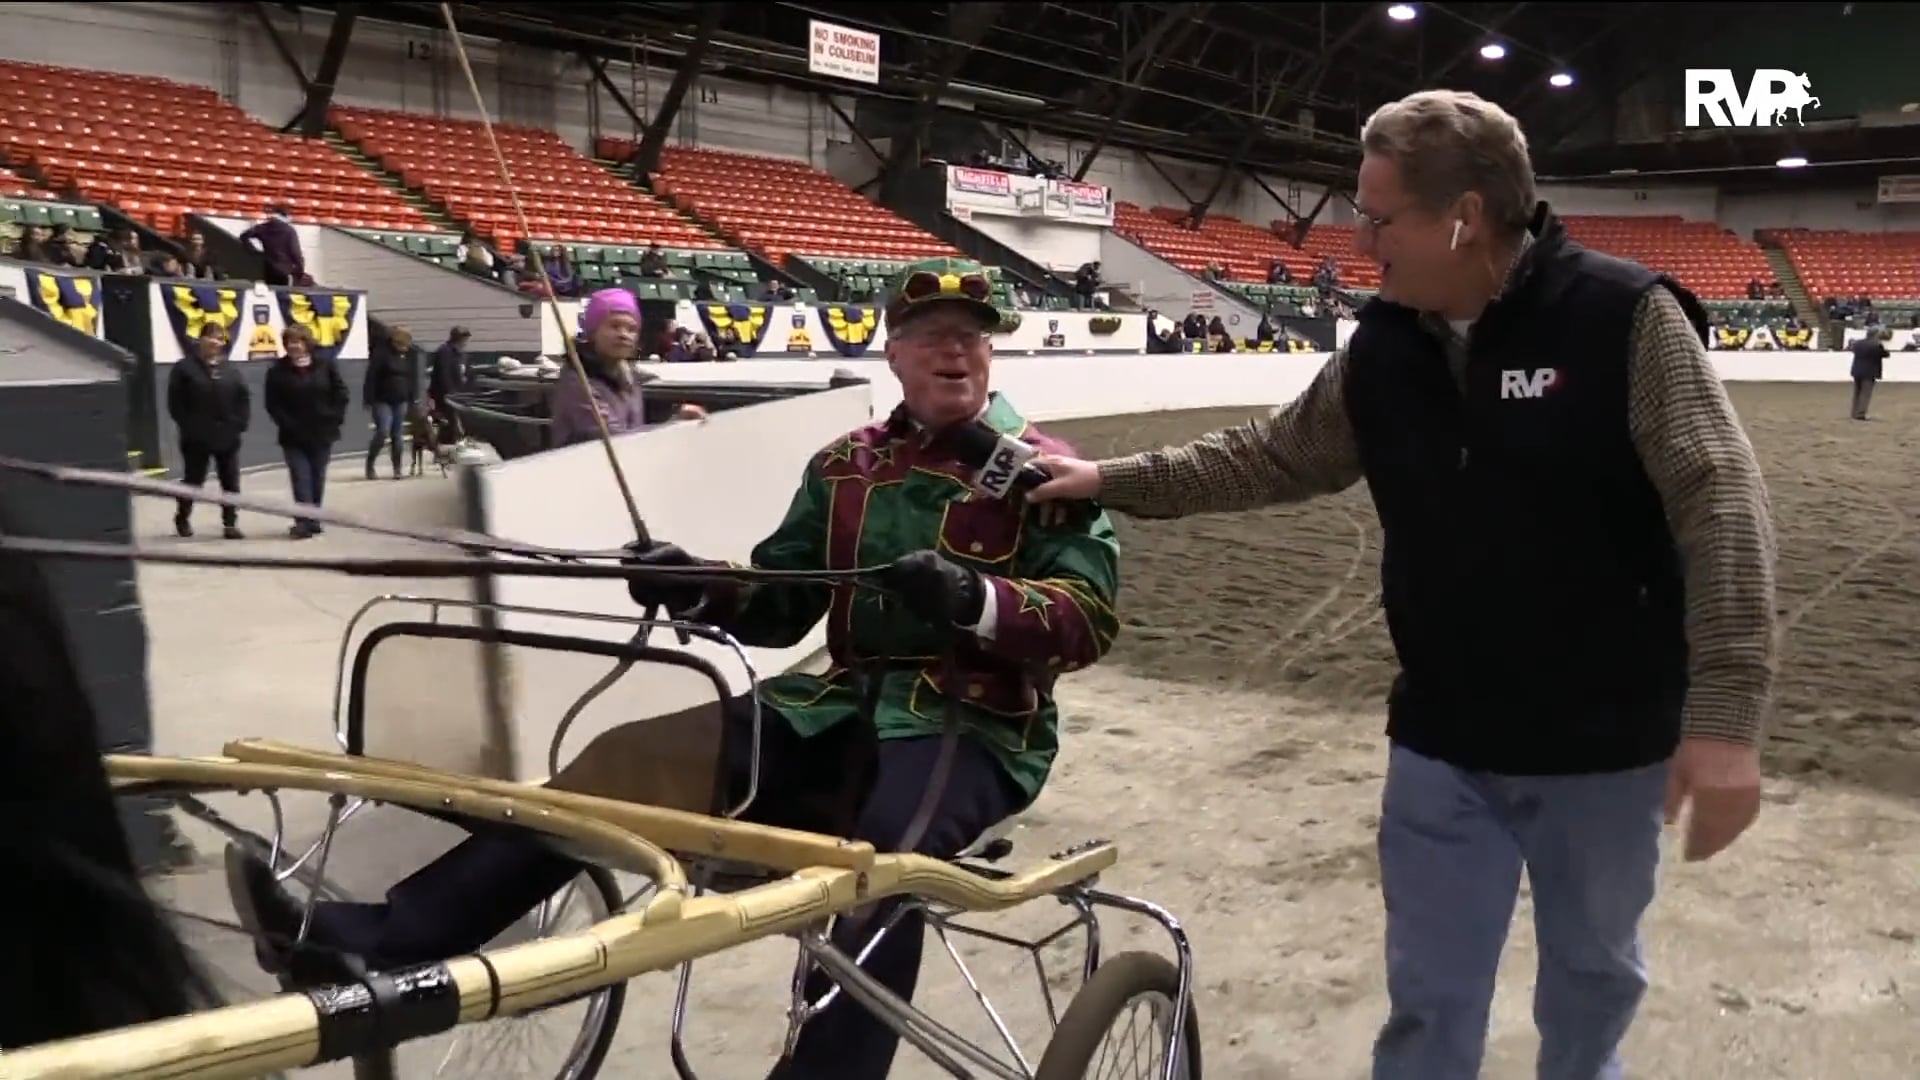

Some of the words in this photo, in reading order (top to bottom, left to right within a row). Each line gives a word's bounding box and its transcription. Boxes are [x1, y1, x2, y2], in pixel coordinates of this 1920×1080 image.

[409, 41, 431, 60] 12
[814, 27, 829, 41] NO
[833, 31, 876, 51] SMOKING
[814, 41, 824, 55] IN
[828, 44, 876, 65] COLISEUM
[1501, 368, 1556, 399] RVP
[981, 447, 1015, 493] RVP
